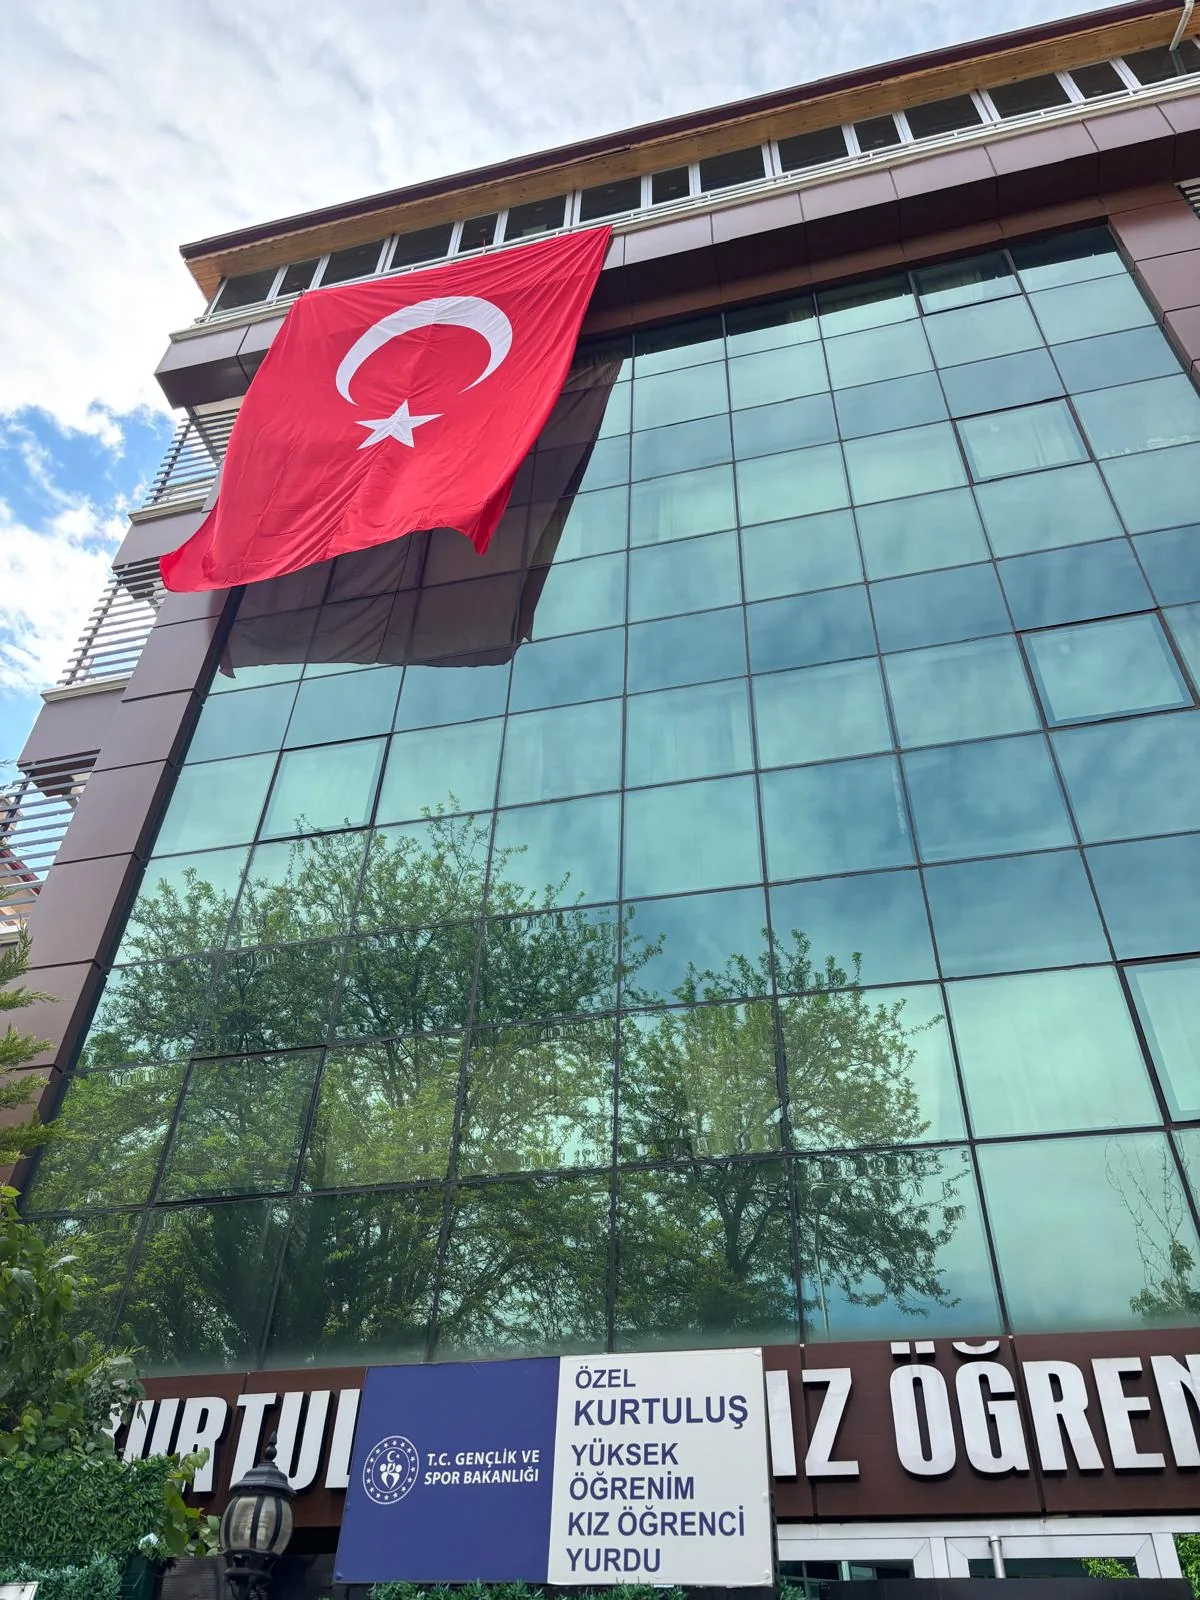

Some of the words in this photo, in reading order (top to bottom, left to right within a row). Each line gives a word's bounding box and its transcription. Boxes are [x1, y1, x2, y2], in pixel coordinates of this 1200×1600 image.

[575, 1366, 637, 1390] ÖZEL
[574, 1395, 749, 1430] KURTULUŞ
[101, 1388, 361, 1493] URTUL
[571, 1438, 679, 1467] YÜKSEK
[427, 1453, 451, 1466] T.C.
[455, 1448, 517, 1468] GENÇLİK
[521, 1449, 540, 1463] VE
[424, 1471, 460, 1485] SPOR
[463, 1466, 539, 1485] BAKANLIĞI
[569, 1470, 695, 1501] ÖĞRENİM
[567, 1511, 610, 1537] KIZ
[617, 1504, 745, 1537] ÖĞRENCİ
[566, 1547, 661, 1573] YURDU
